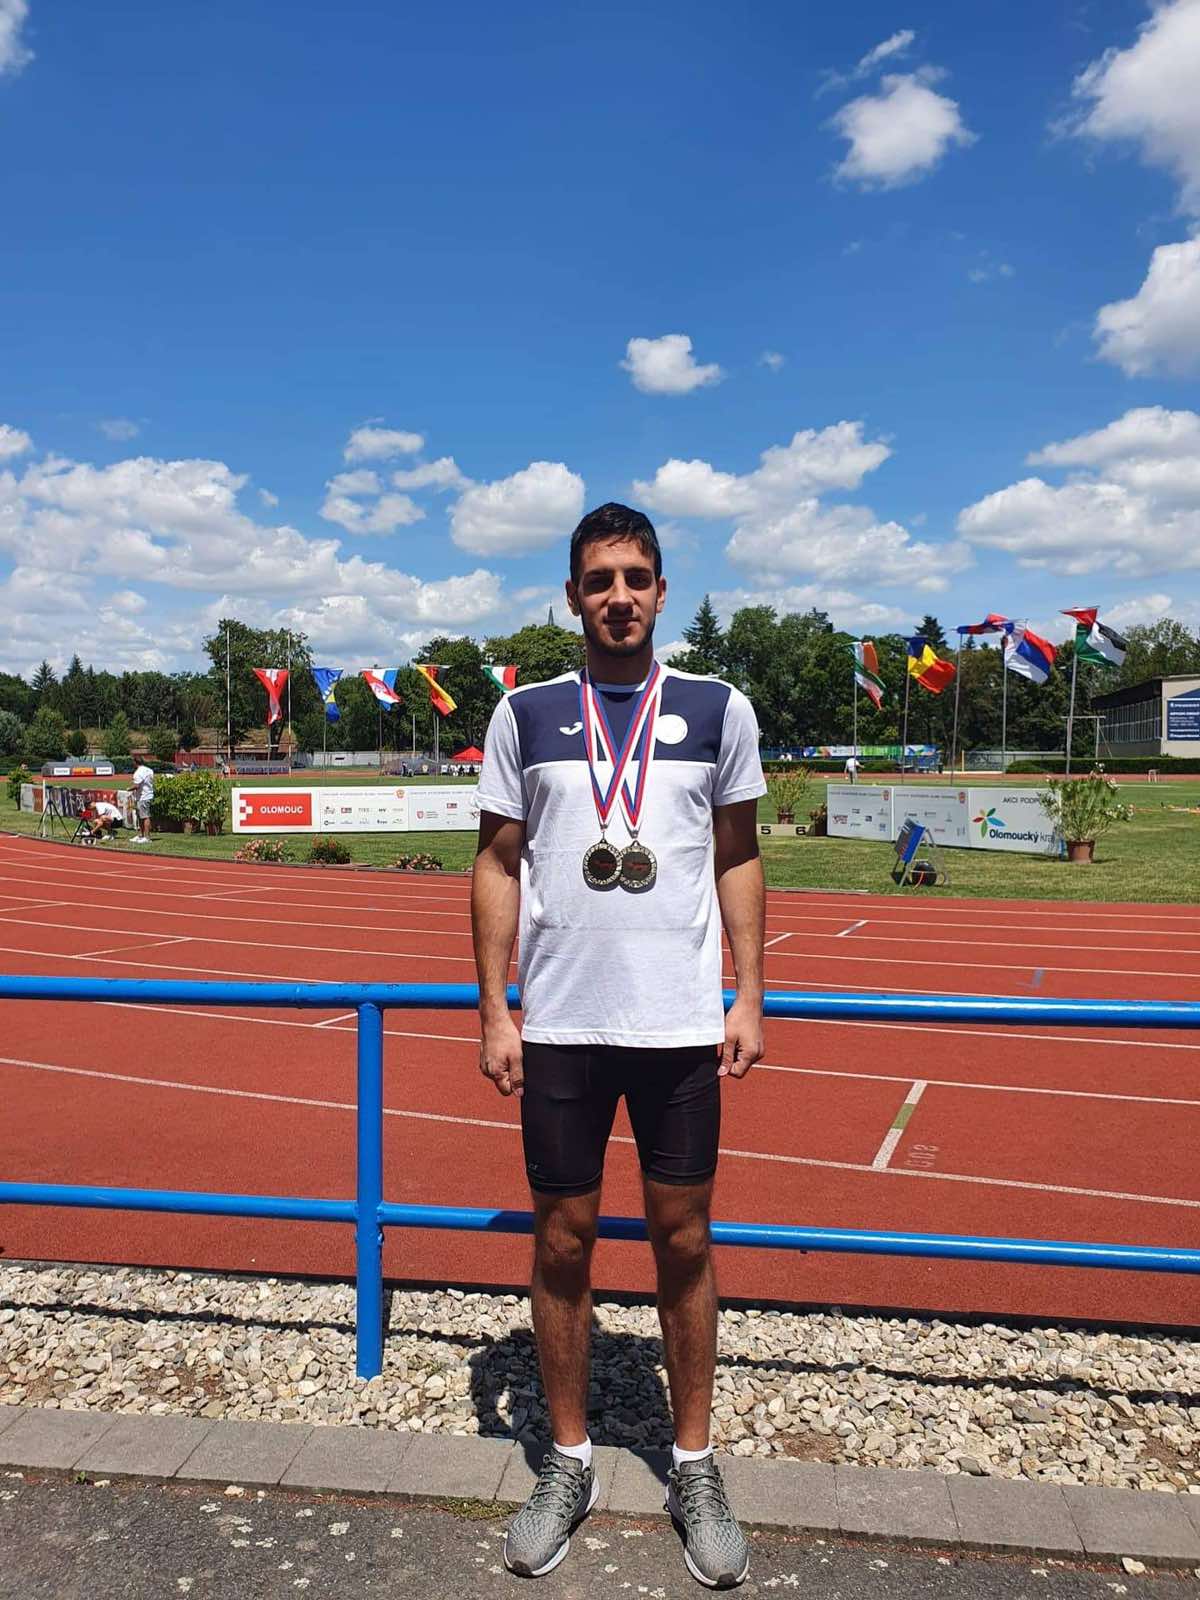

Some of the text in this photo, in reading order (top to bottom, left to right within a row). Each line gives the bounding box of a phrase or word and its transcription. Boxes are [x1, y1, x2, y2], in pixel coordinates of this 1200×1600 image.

[260, 805, 305, 814] OLOMOUC
[760, 825, 807, 836] 5 6
[989, 829, 1039, 843] Olomoucký
